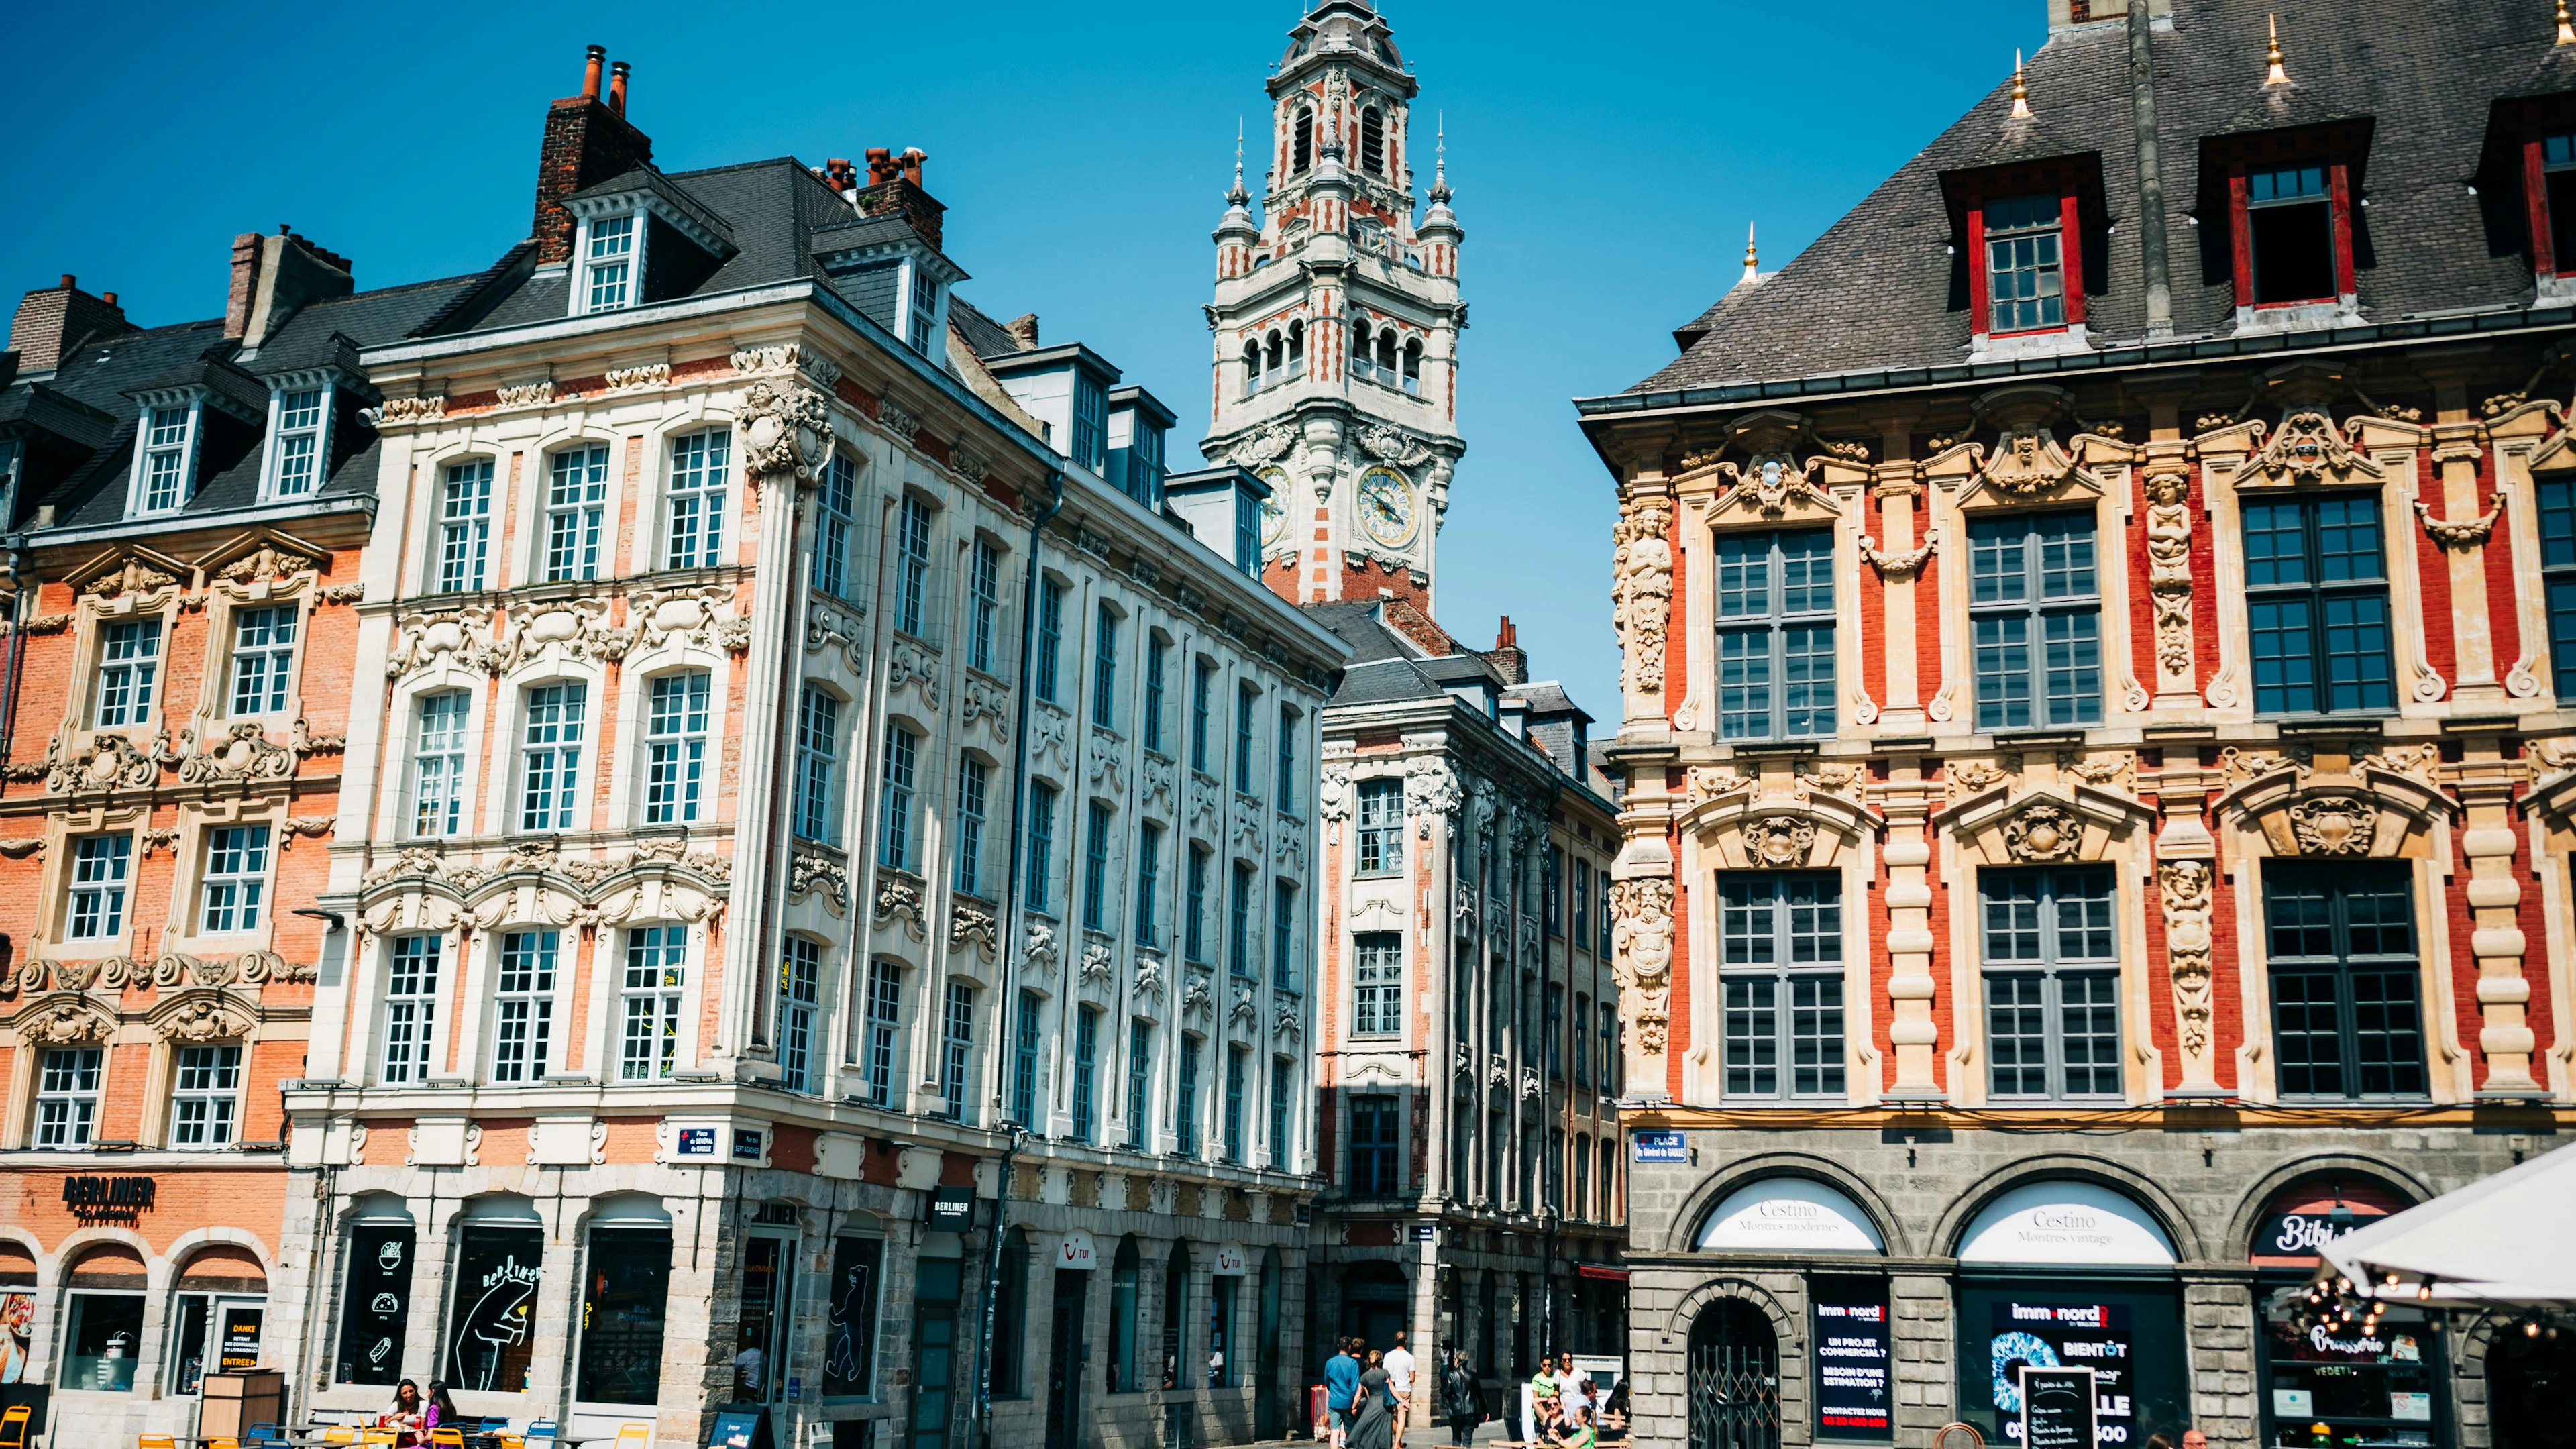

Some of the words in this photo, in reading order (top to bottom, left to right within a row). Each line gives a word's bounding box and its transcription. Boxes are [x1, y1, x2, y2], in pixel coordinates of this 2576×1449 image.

[1654, 1136, 1678, 1146] PLACE
[1637, 1148, 1643, 1157] du
[1660, 1148, 1667, 1157] de
[1668, 1148, 1684, 1157] GAULLE
[62, 1176, 154, 1203] BERLINER
[934, 1201, 969, 1212] BERLINER
[1760, 1199, 1817, 1217] Cestino
[2033, 1210, 2096, 1228] Cestino
[1739, 1220, 1784, 1230] Montres
[1787, 1220, 1839, 1232] modernes
[2018, 1231, 2067, 1242] Montres
[2070, 1232, 2113, 1246] vintage
[1079, 1249, 1089, 1259] TUI
[744, 1265, 776, 1273] ILLKOMMEN
[1232, 1259, 1240, 1269] TUI
[233, 1325, 256, 1333] DANKE
[1828, 1337, 1841, 1346] UN
[1842, 1338, 1878, 1348] PROJET
[2310, 1324, 2385, 1354] Brasserie
[1819, 1346, 1880, 1358] COMMERCIAL
[1880, 1348, 1887, 1358] ?
[2063, 1340, 2127, 1358] BIENTÔT
[222, 1358, 250, 1366] ENTREE
[1823, 1366, 1856, 1377] BESOIN
[1856, 1367, 1884, 1378] D'UNE
[1823, 1377, 1877, 1387] ESTIMATION
[1878, 1378, 1884, 1387] ?
[1822, 1406, 1866, 1416] CONTACTEZ
[1866, 1408, 1887, 1417] NOUS
